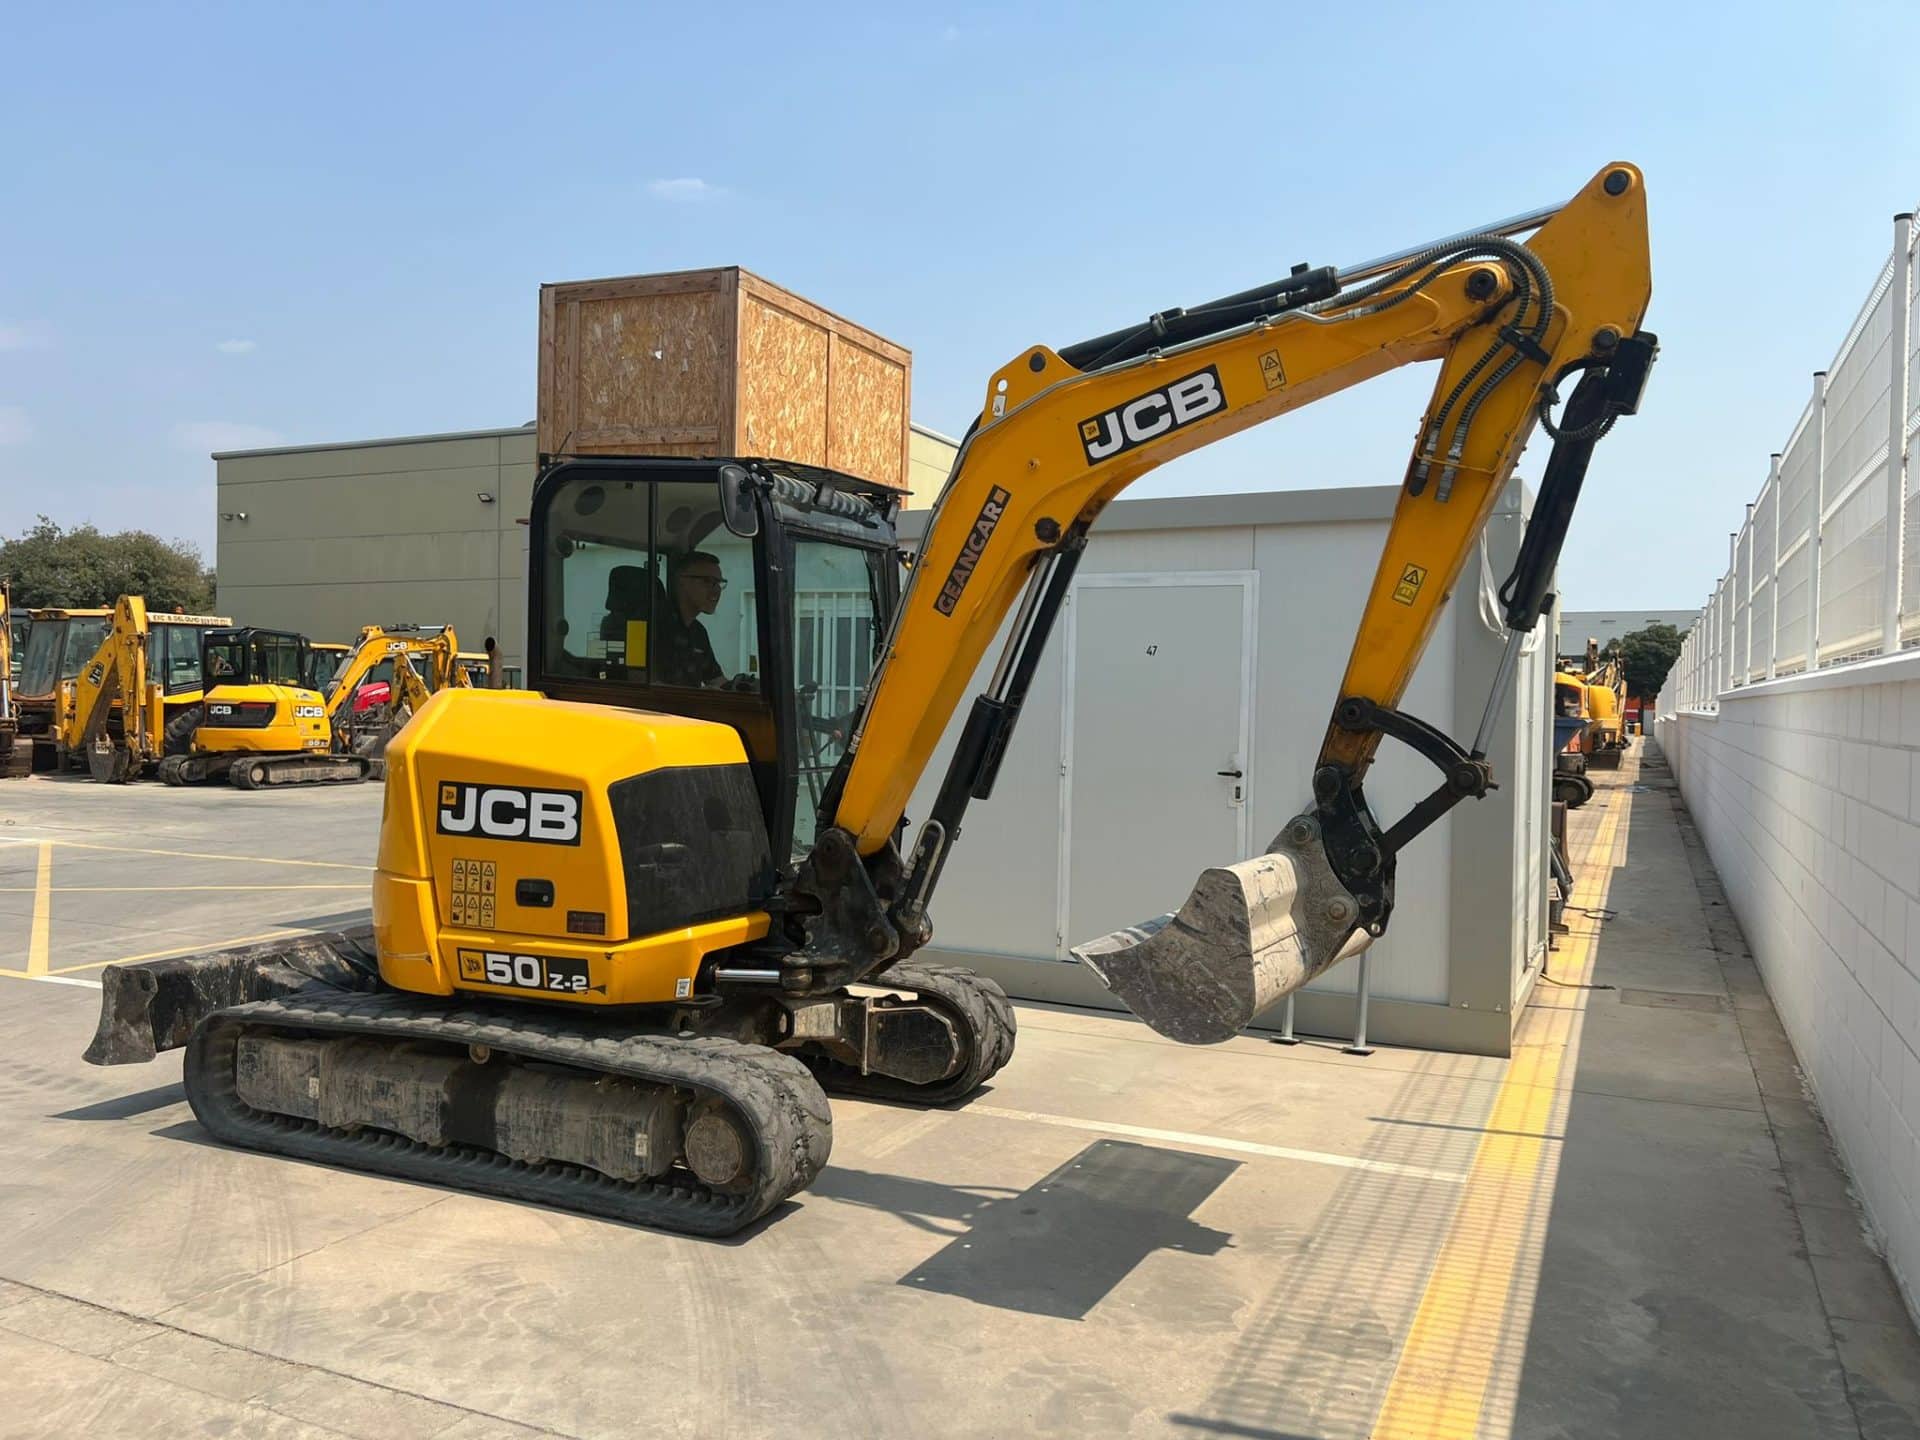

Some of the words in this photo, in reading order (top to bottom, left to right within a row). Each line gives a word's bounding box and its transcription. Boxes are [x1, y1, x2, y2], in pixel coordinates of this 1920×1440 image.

[1087, 371, 1222, 459] JCB
[937, 501, 1002, 614] GEANCAR
[386, 641, 408, 651] JCB
[1146, 645, 1158, 656] 47
[210, 705, 232, 715] JCB
[295, 706, 323, 717] JCB
[440, 787, 578, 841] JCB
[485, 952, 541, 987] 50
